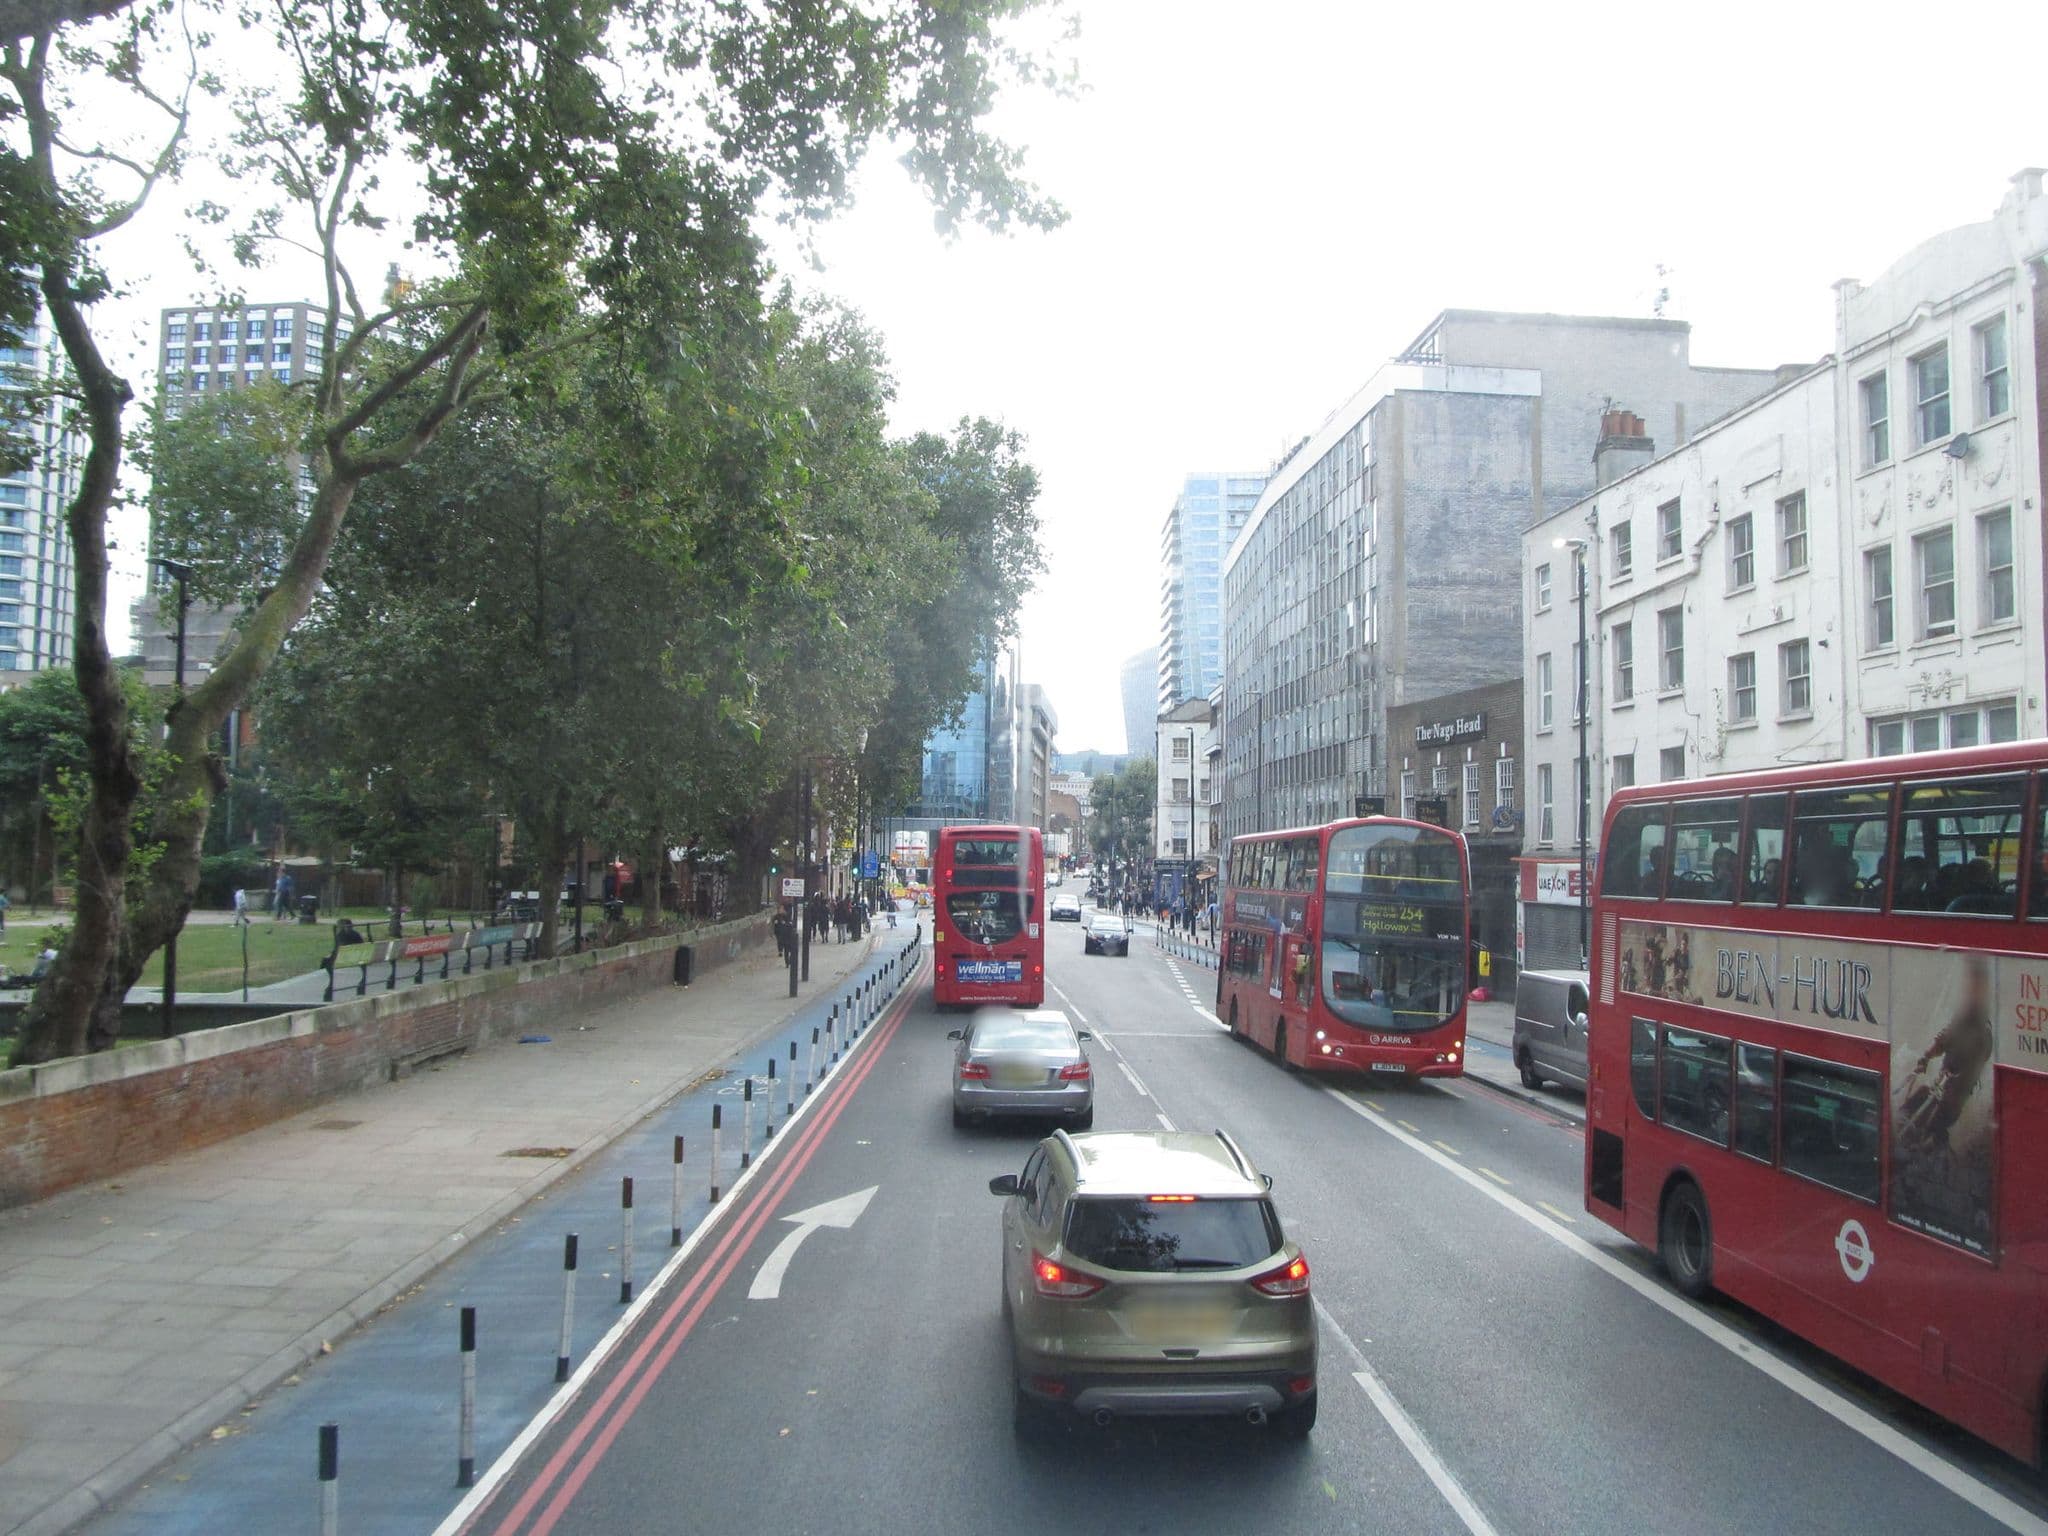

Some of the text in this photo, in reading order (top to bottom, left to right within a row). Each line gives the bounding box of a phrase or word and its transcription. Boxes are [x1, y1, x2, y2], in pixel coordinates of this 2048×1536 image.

[1415, 715, 1481, 741] The Nags Head
[982, 892, 998, 904] 25
[1400, 905, 1424, 920] 254
[1363, 919, 1409, 933] Holloway
[958, 961, 1006, 974] wellman
[1716, 949, 1878, 1024] BEN-HUR
[1382, 1035, 1412, 1045] ARRIVA
[2018, 1035, 2032, 1053] IN
